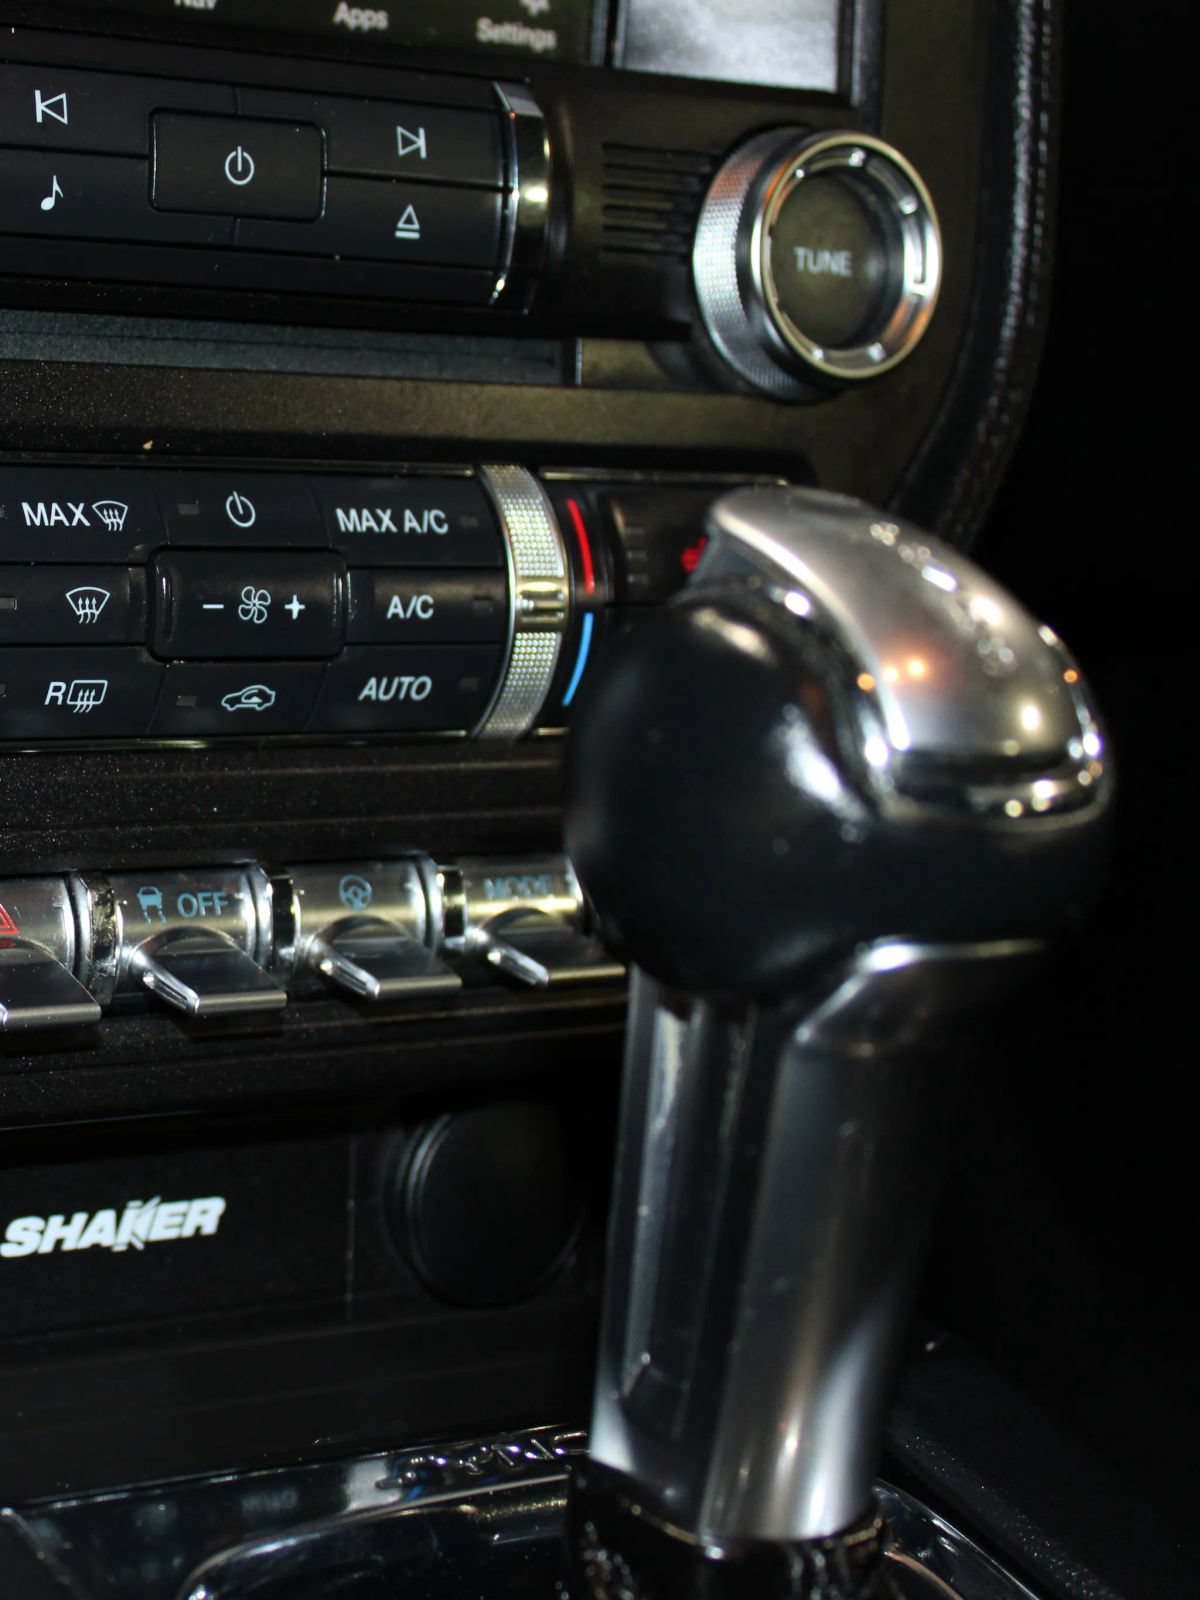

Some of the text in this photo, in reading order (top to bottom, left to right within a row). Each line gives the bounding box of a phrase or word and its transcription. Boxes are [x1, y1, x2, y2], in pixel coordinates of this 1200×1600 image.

[333, 1, 389, 32] Apps
[475, 16, 557, 52] Settings
[793, 246, 853, 277] TUNE
[21, 502, 91, 528] MAX
[335, 508, 450, 535] MAX A/C
[386, 594, 435, 620] A/C
[44, 681, 66, 706] R
[358, 675, 432, 702] AUTO
[176, 890, 230, 919] OFF
